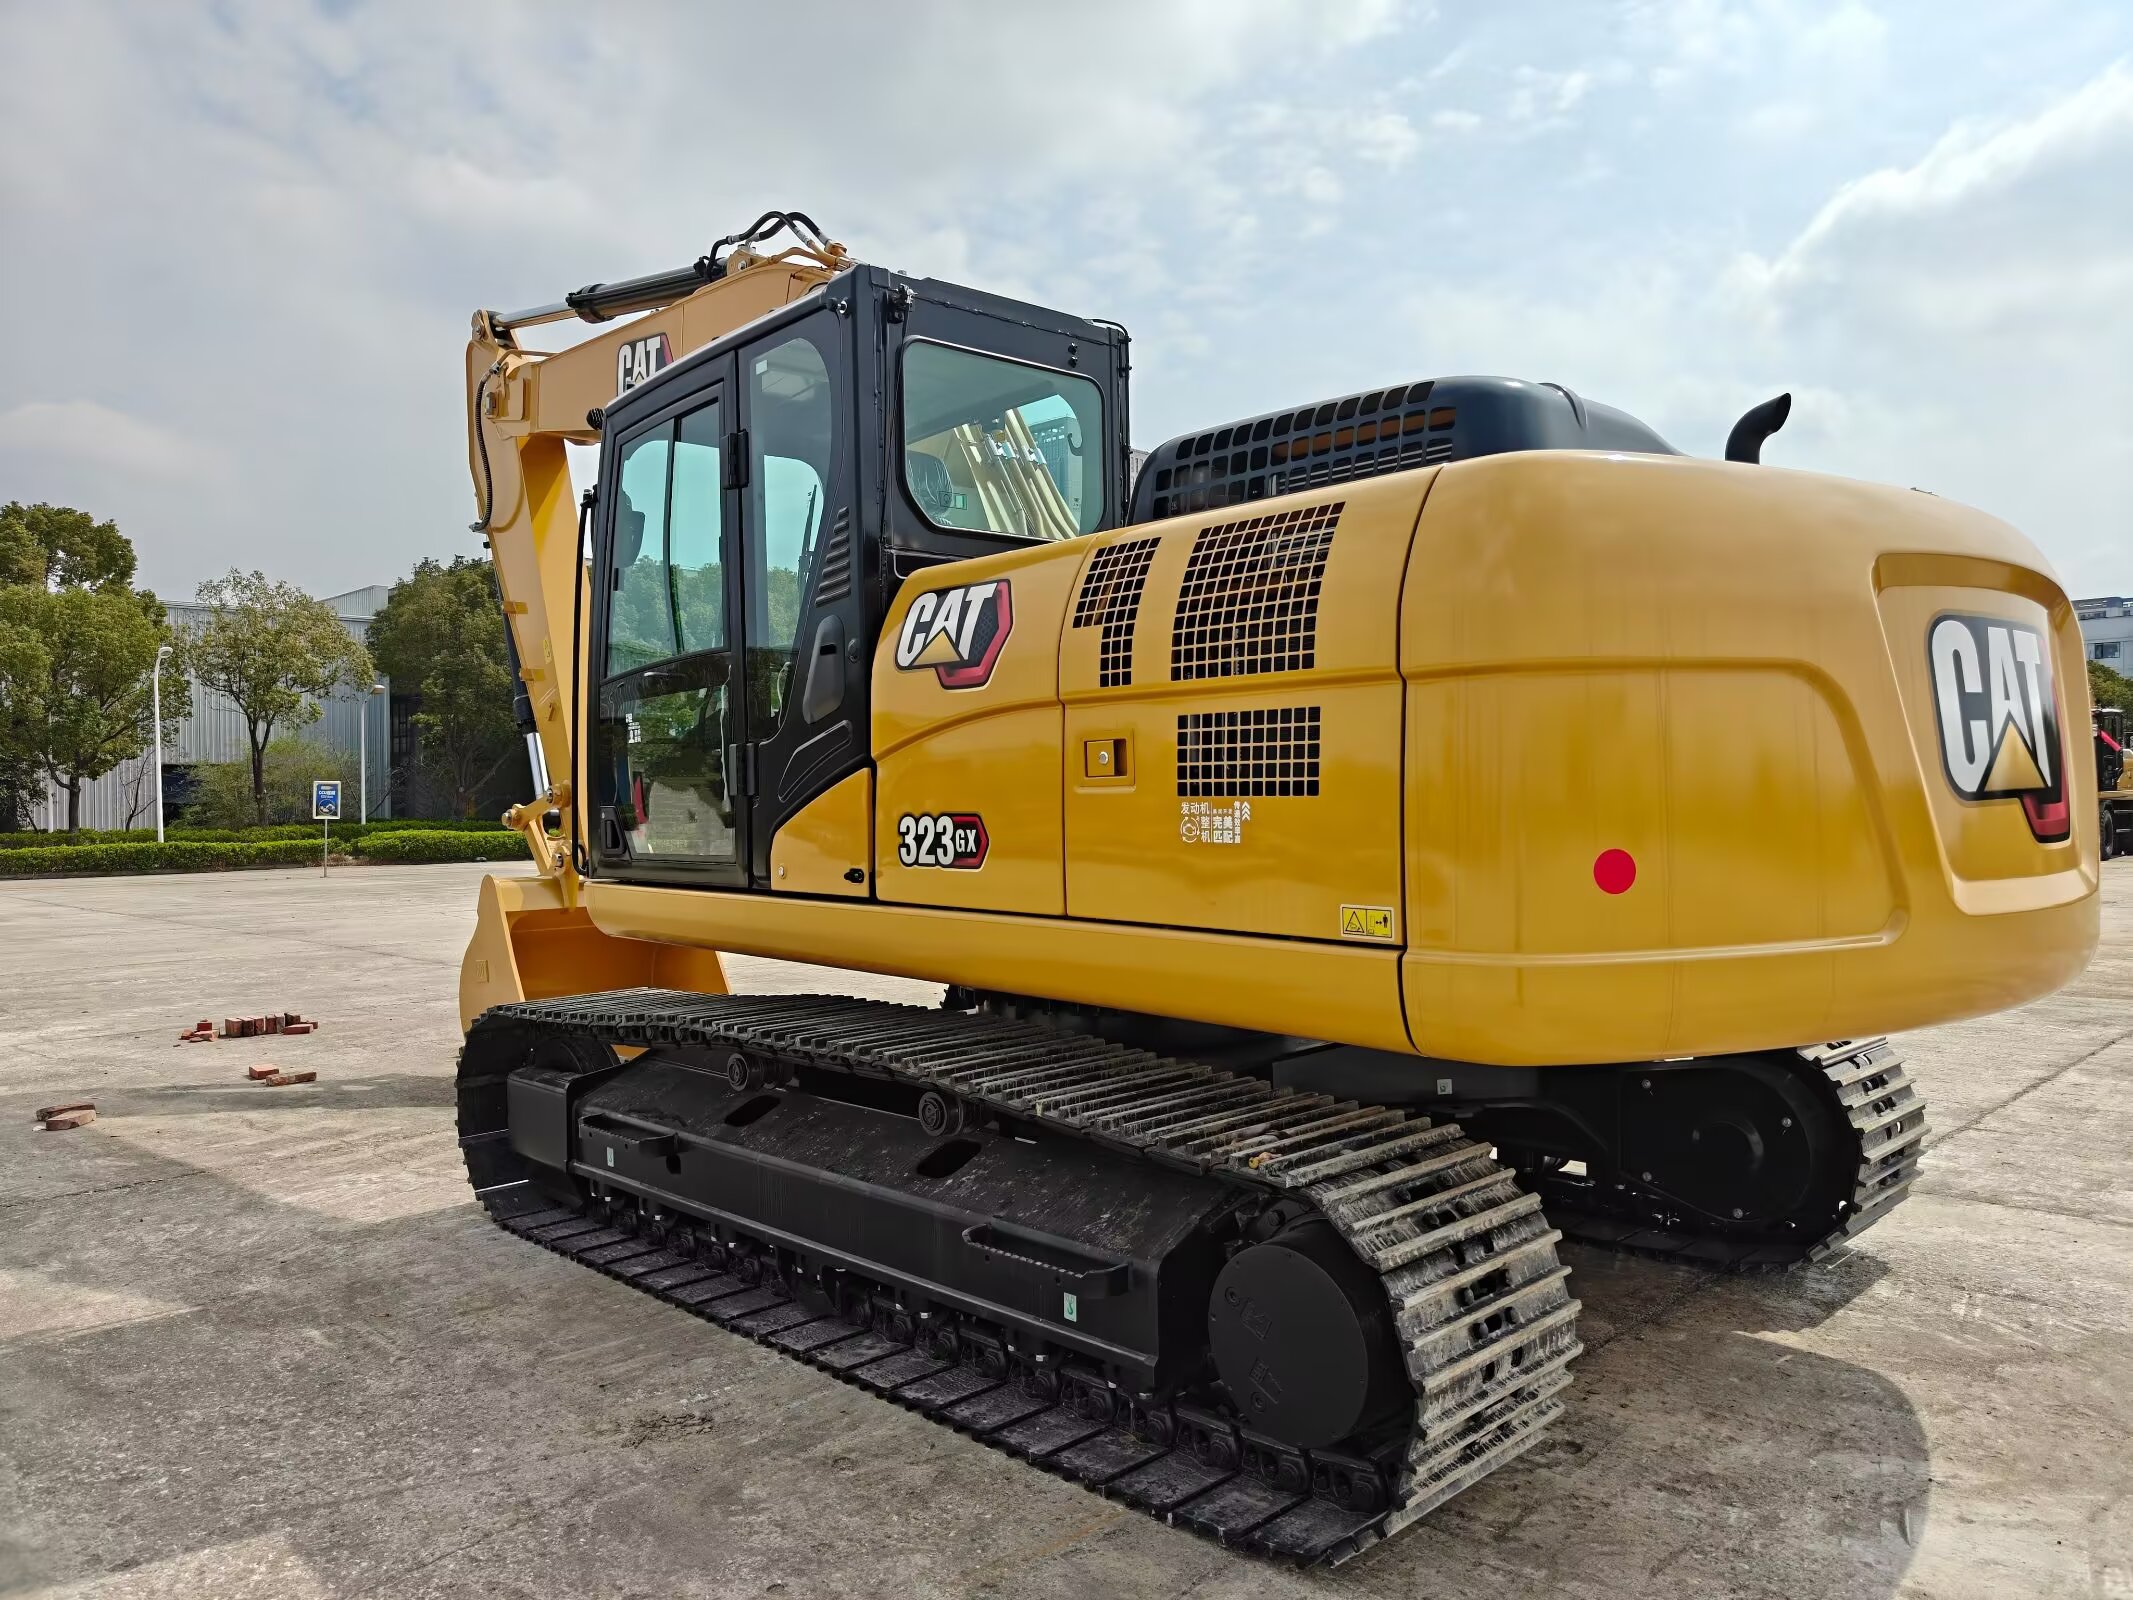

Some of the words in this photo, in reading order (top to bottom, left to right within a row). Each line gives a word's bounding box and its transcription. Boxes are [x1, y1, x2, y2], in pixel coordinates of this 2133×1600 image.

[618, 335, 661, 397] CAT
[897, 583, 998, 667] CAT
[1932, 619, 2052, 792] CAT
[1181, 802, 1210, 815] 发动机
